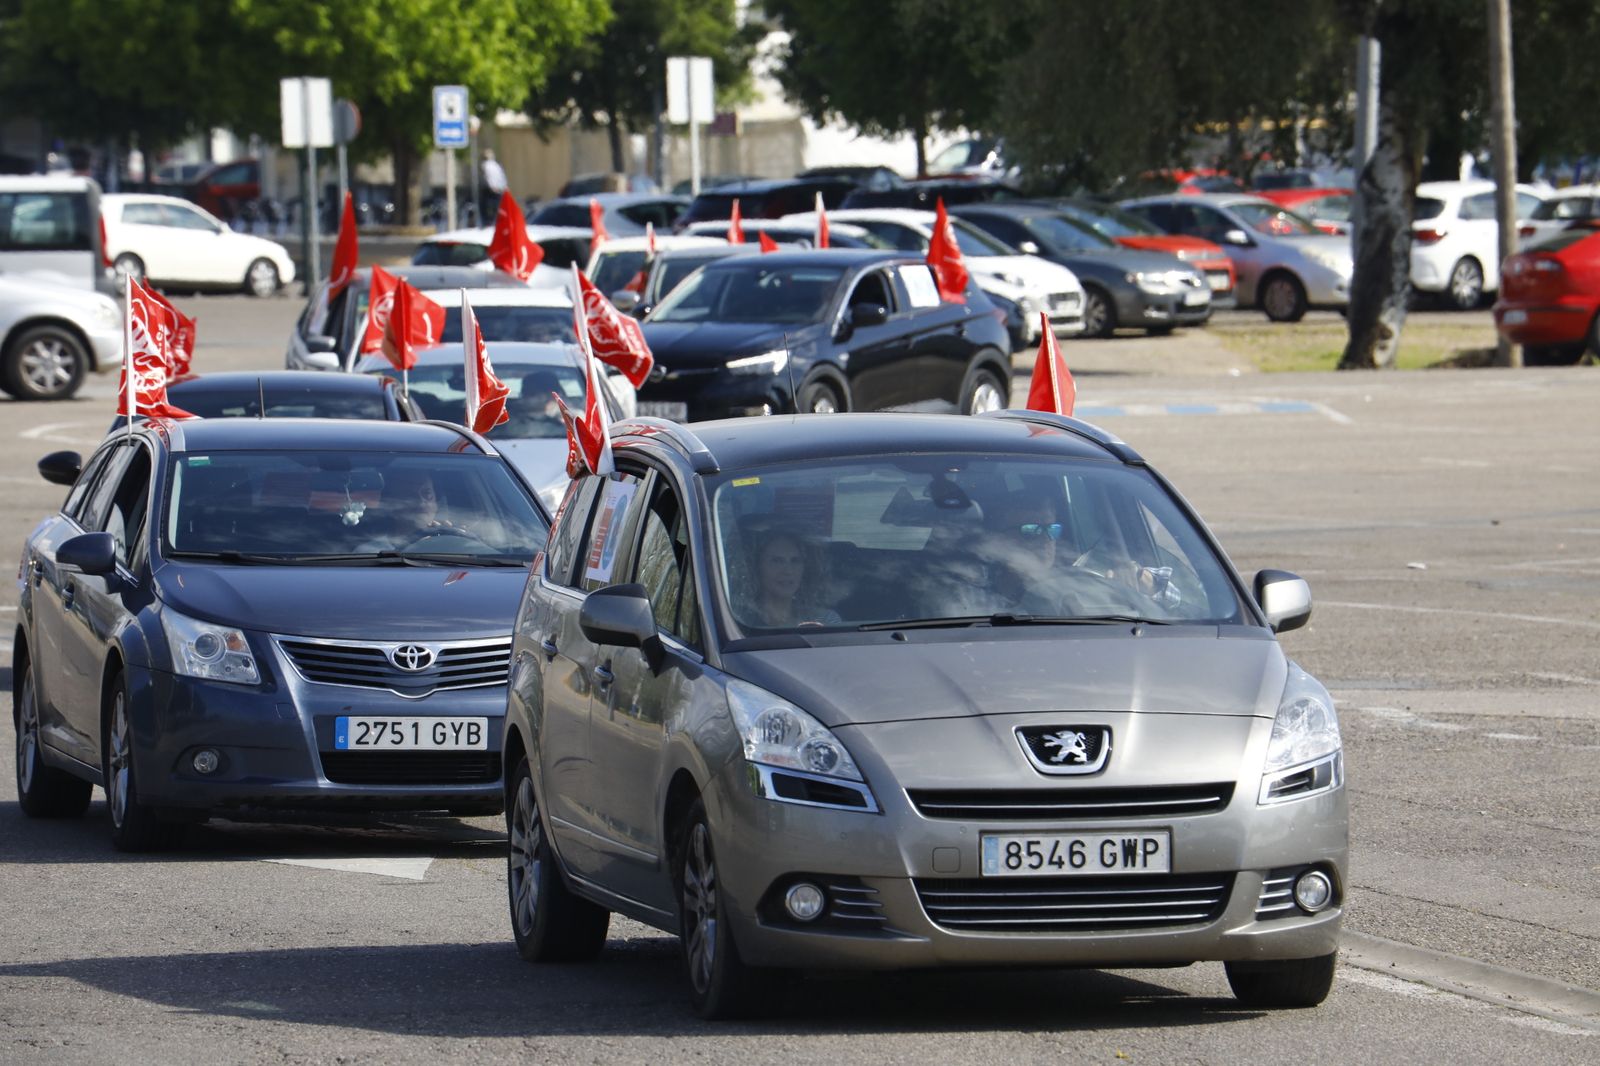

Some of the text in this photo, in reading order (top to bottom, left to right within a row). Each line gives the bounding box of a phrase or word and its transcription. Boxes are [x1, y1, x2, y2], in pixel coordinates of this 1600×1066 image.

[355, 721, 482, 746] 2751 GYB
[1005, 838, 1160, 870] 8546 GWP
